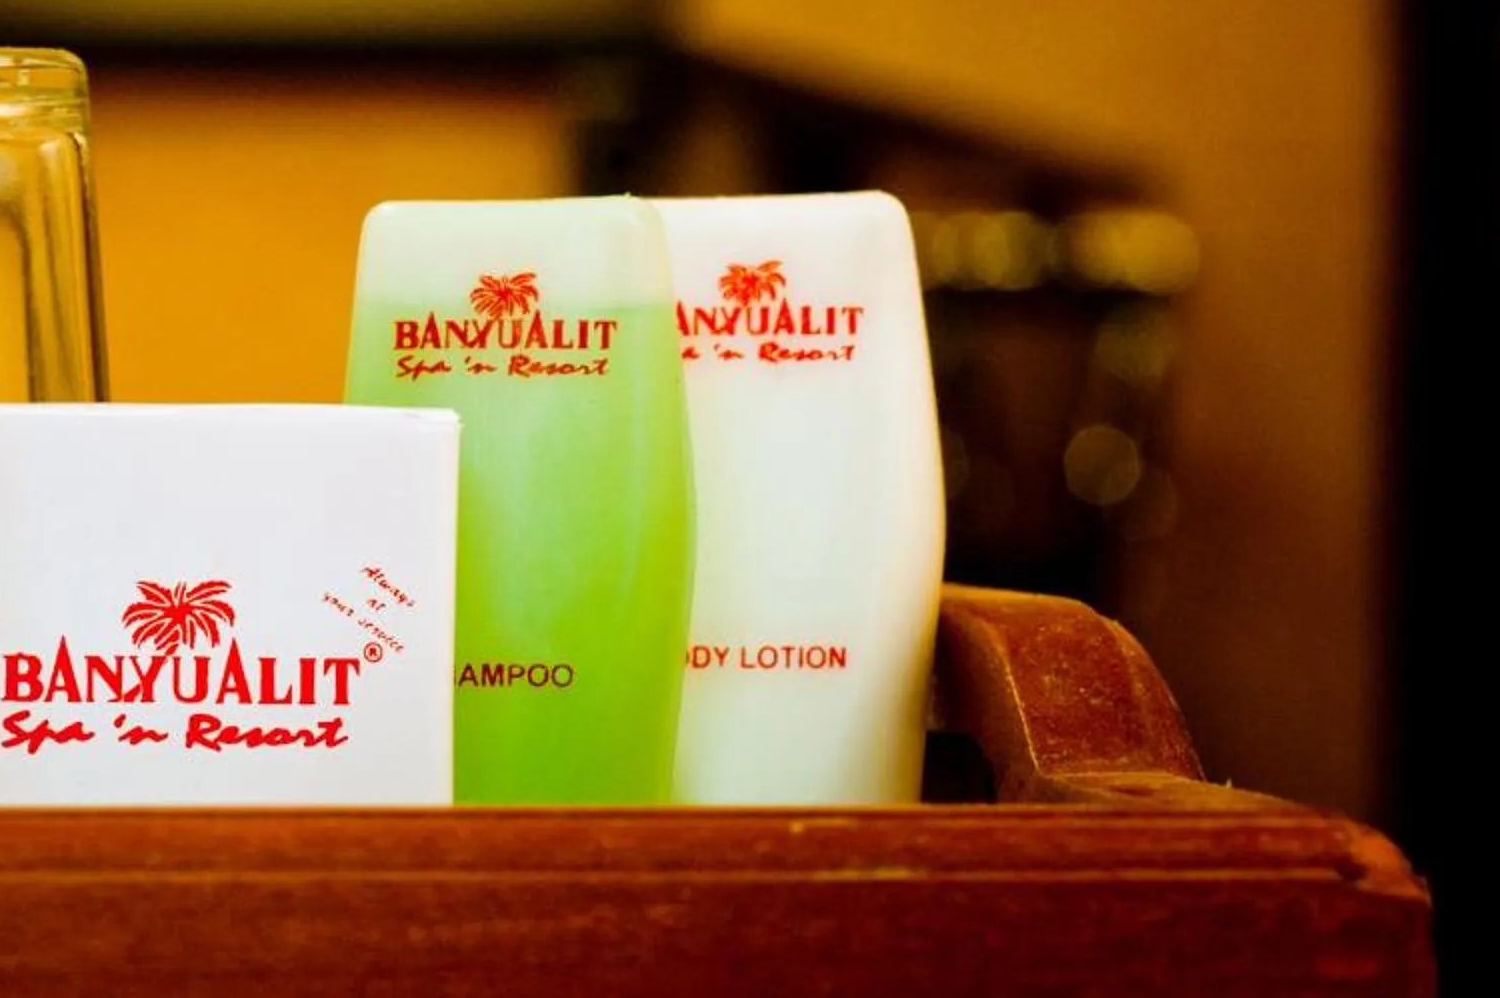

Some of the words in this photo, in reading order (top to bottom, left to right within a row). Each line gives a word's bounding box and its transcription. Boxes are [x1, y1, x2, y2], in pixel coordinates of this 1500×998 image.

[393, 310, 618, 350] BANYUALIT
[758, 341, 855, 363] Resort
[396, 355, 452, 382] Spa
[507, 354, 609, 378] Resort
[1, 634, 361, 706] BANYUALIT
[686, 644, 731, 670] DY
[739, 644, 848, 671] LOTION
[453, 662, 575, 688] AMPOO
[2, 709, 95, 755] Spa
[185, 712, 349, 752] Resort
